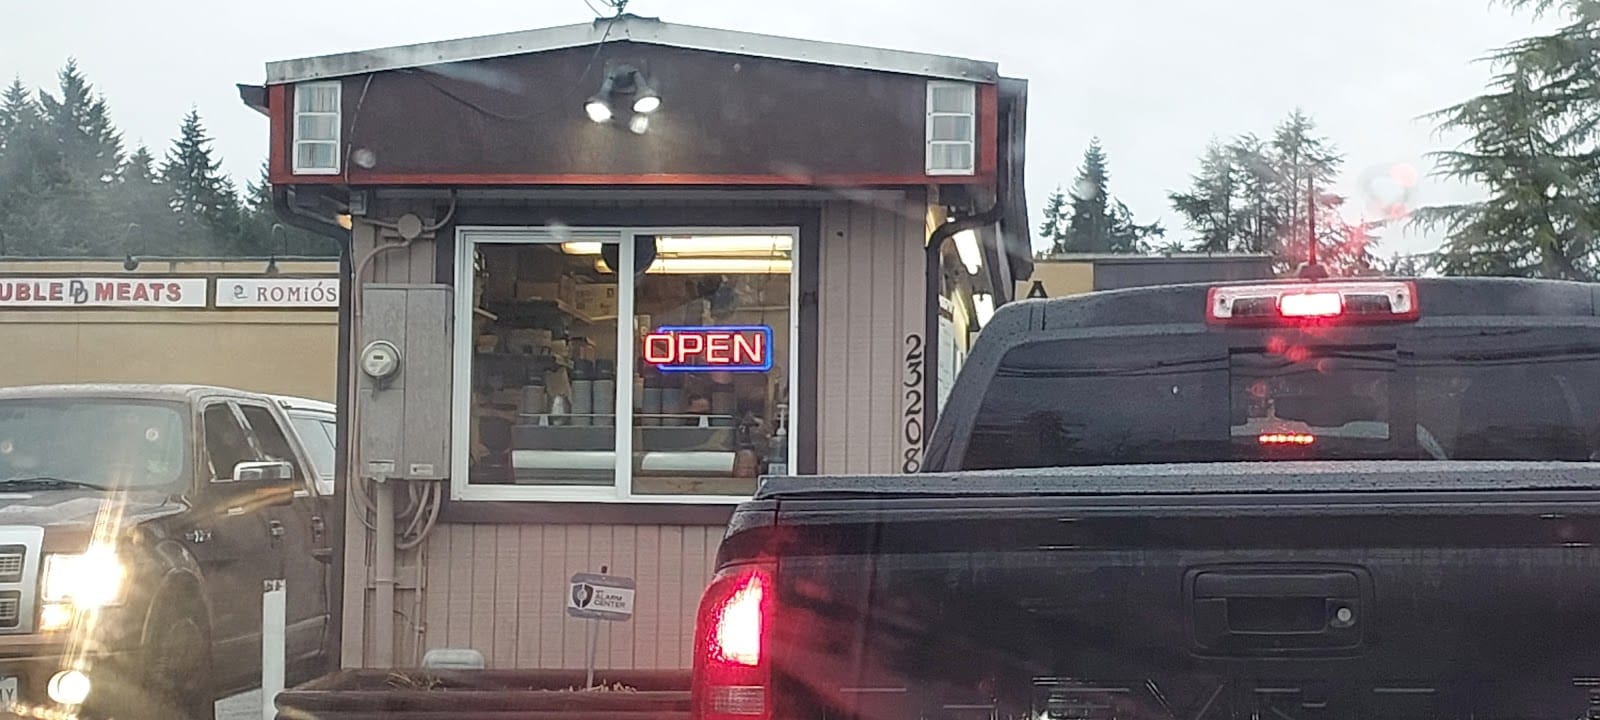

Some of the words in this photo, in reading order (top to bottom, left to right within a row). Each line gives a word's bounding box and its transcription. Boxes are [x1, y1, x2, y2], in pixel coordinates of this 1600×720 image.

[0, 283, 64, 301] UBLE
[95, 283, 182, 301] MEATS
[643, 332, 763, 364] OPEN
[903, 334, 922, 474] 23208
[594, 600, 626, 608] CENTER
[595, 592, 623, 601] ALARM
